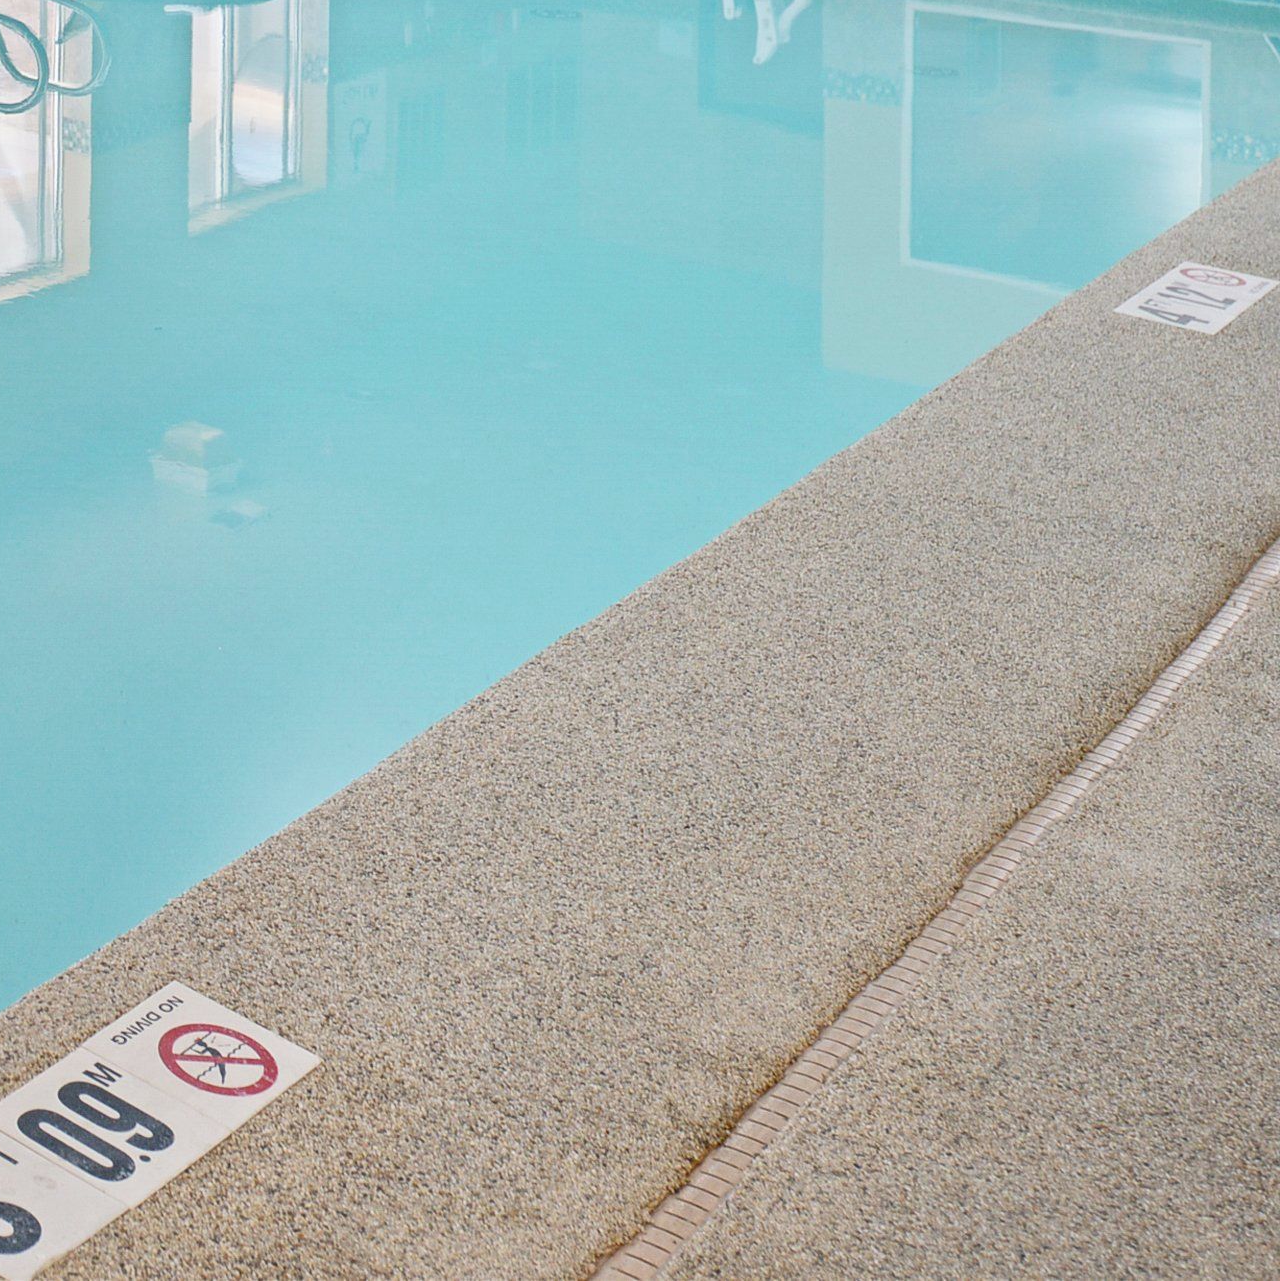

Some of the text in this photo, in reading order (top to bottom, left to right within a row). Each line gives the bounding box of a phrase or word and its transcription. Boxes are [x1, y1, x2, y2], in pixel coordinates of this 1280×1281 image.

[111, 995, 184, 1045] NO DIVING
[83, 1062, 123, 1089] M
